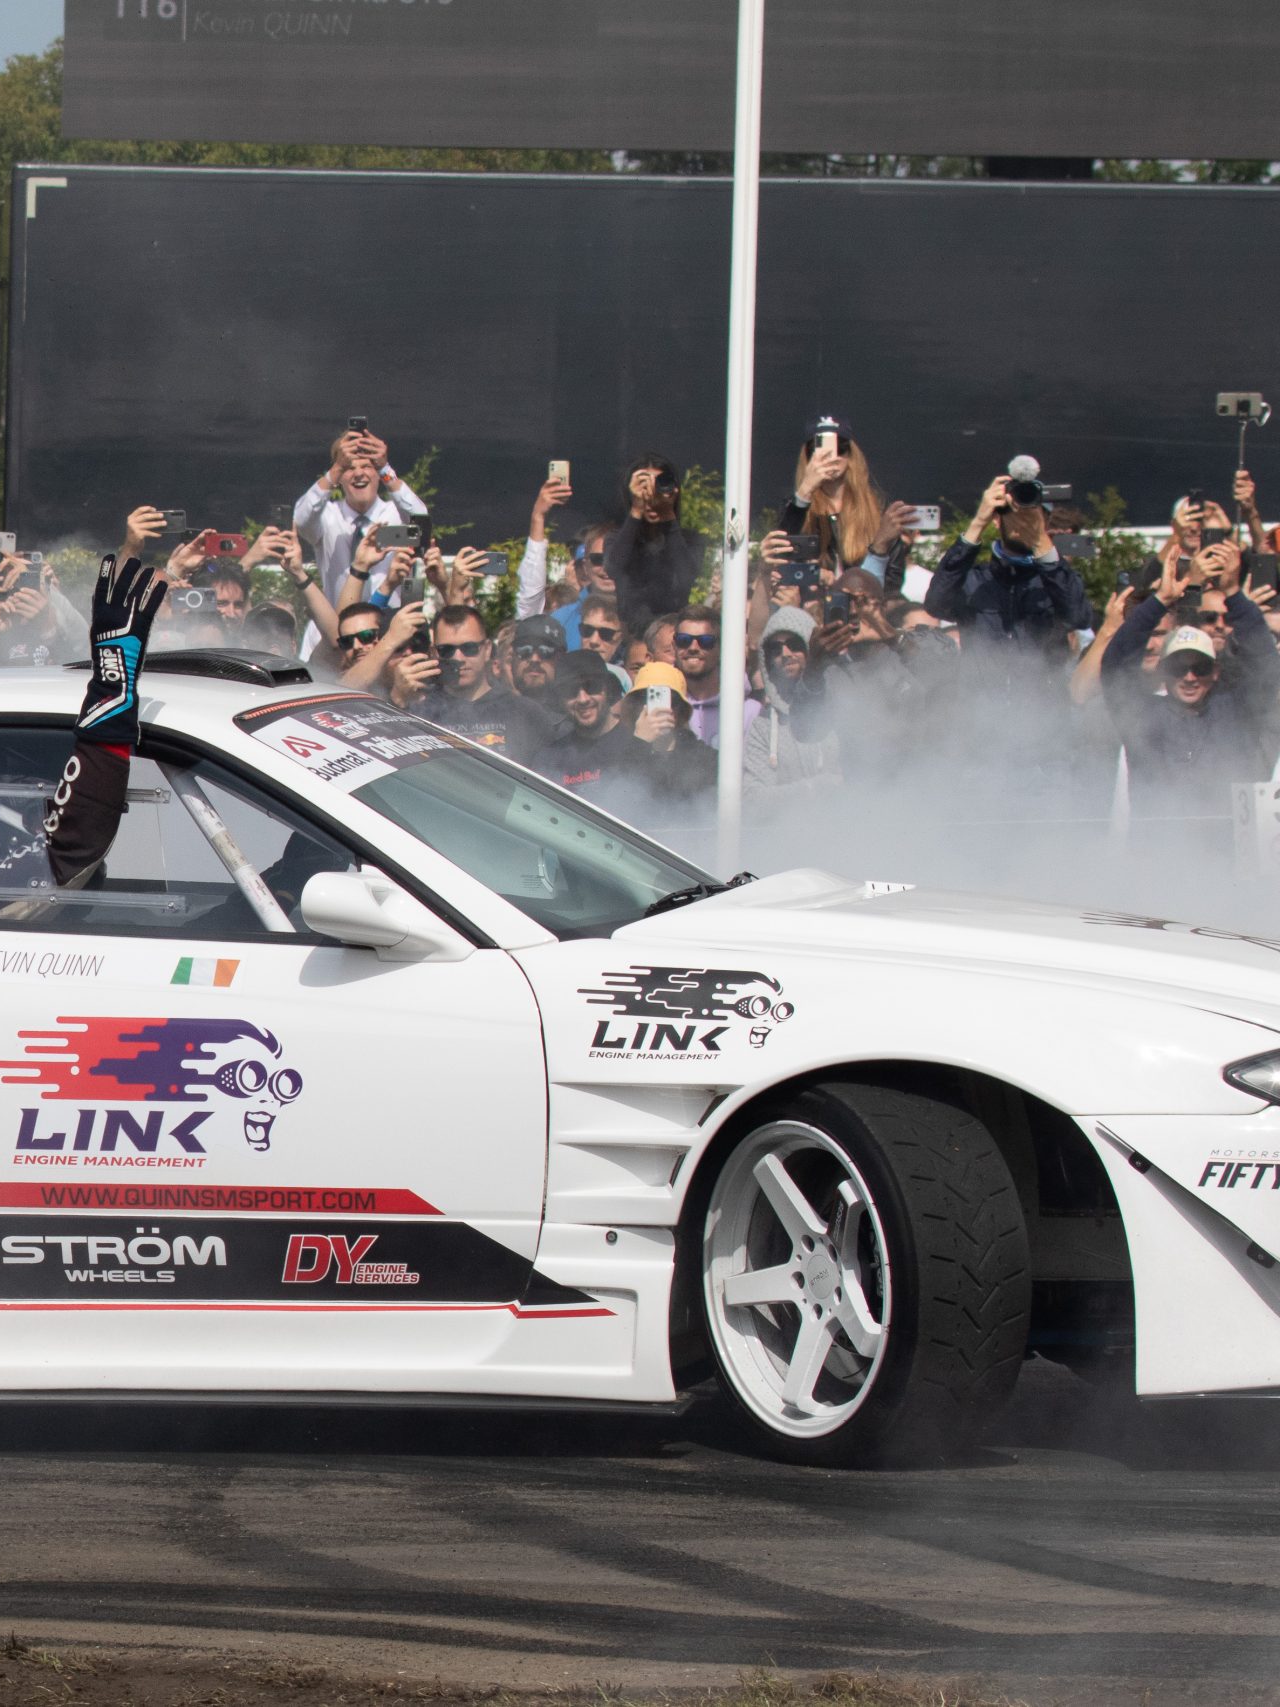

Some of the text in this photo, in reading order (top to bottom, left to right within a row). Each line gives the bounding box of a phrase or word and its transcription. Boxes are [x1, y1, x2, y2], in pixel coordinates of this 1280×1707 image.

[193, 11, 353, 39] Kevin QUINN
[103, 648, 121, 681] OMP
[37, 952, 105, 979] QUINN
[591, 1020, 731, 1051] LINK
[588, 1051, 721, 1061] ENGINE MANAGEMENT
[15, 1108, 216, 1154] LINK
[13, 1155, 208, 1169] ENGINE MANAGEMENT
[41, 1186, 377, 1211] WWW.QUINNSMSPORT.COM
[1, 1226, 227, 1267] STRÖM
[281, 1233, 380, 1285] DY
[64, 1269, 176, 1284] WHEELS
[353, 1273, 420, 1285] SERVICES
[355, 1263, 407, 1275] ENGINE
